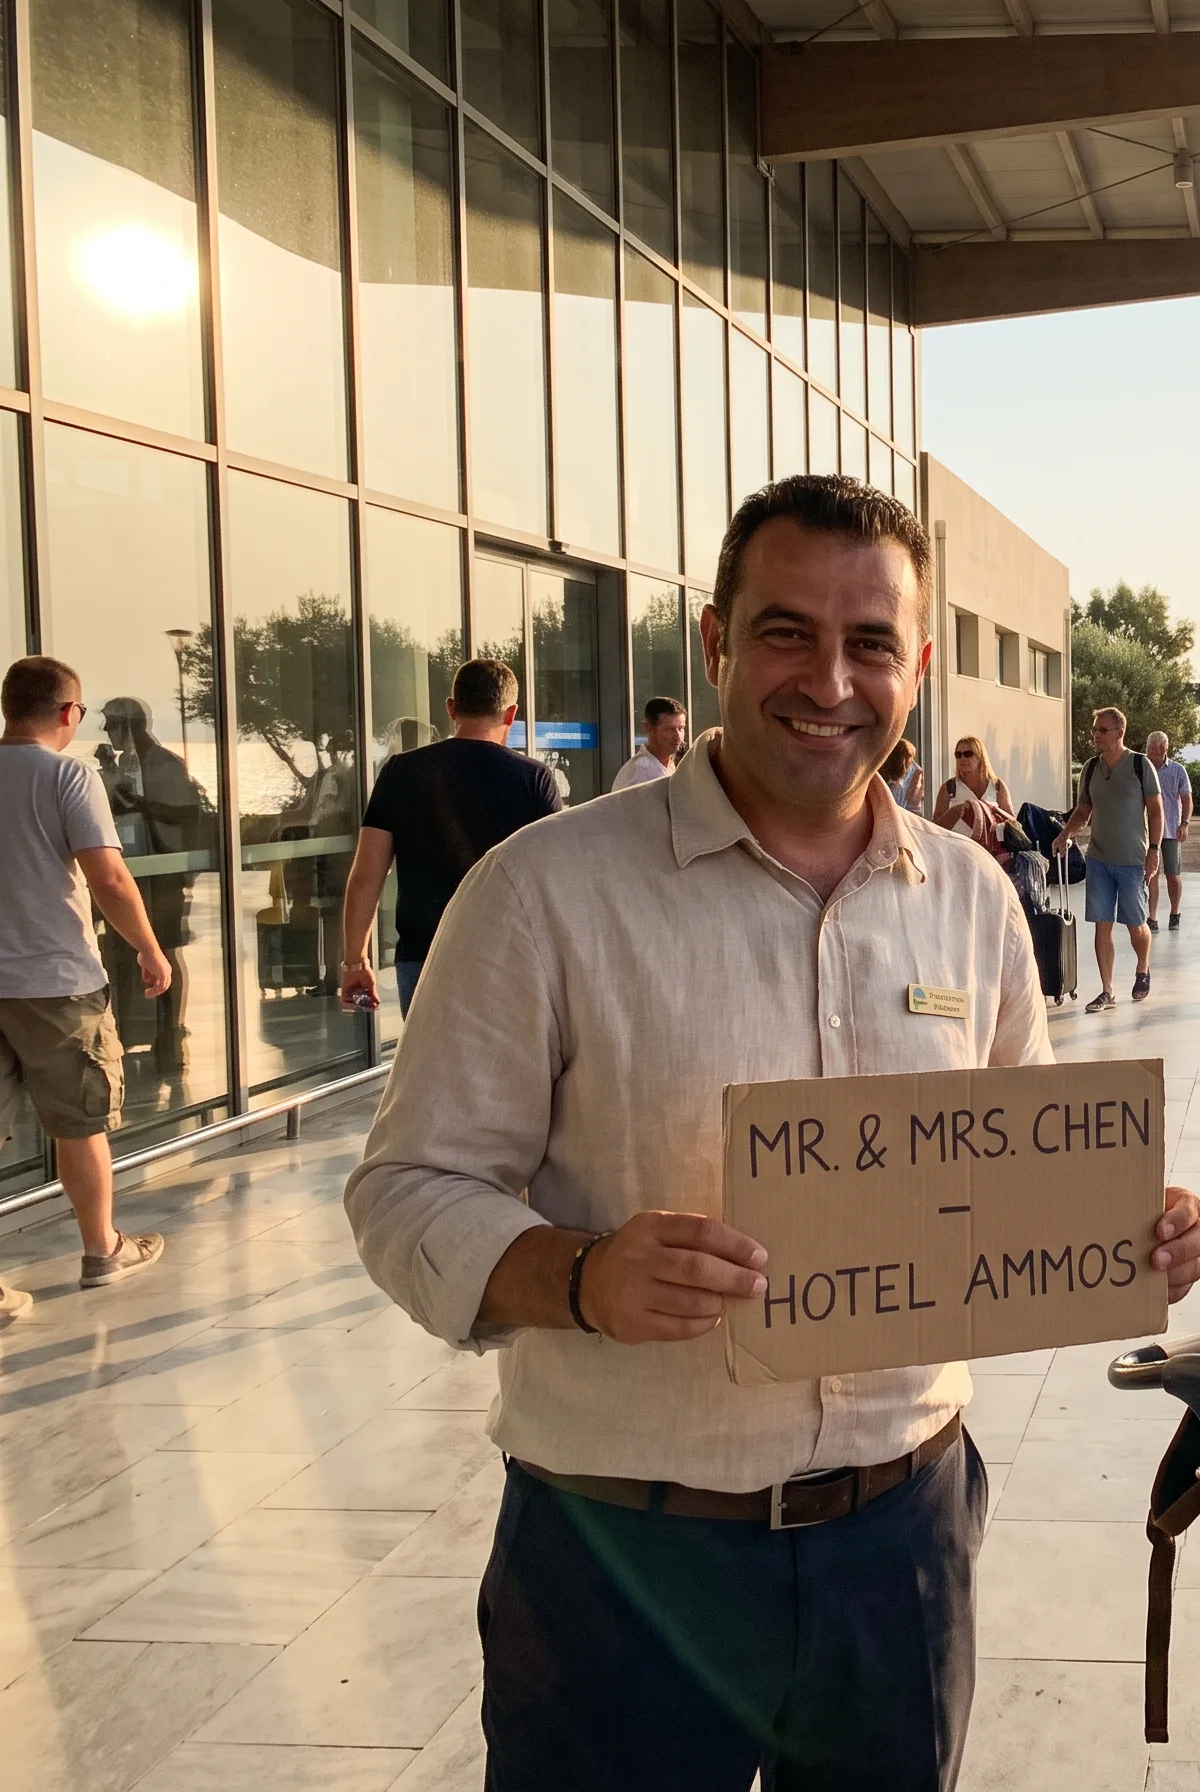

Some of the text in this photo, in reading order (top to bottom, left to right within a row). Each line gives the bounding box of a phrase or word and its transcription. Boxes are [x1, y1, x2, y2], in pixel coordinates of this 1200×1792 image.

[749, 1098, 1150, 1179] MR. & MRS. CHEN
[763, 1239, 1137, 1329] HOTEL AMMOS
